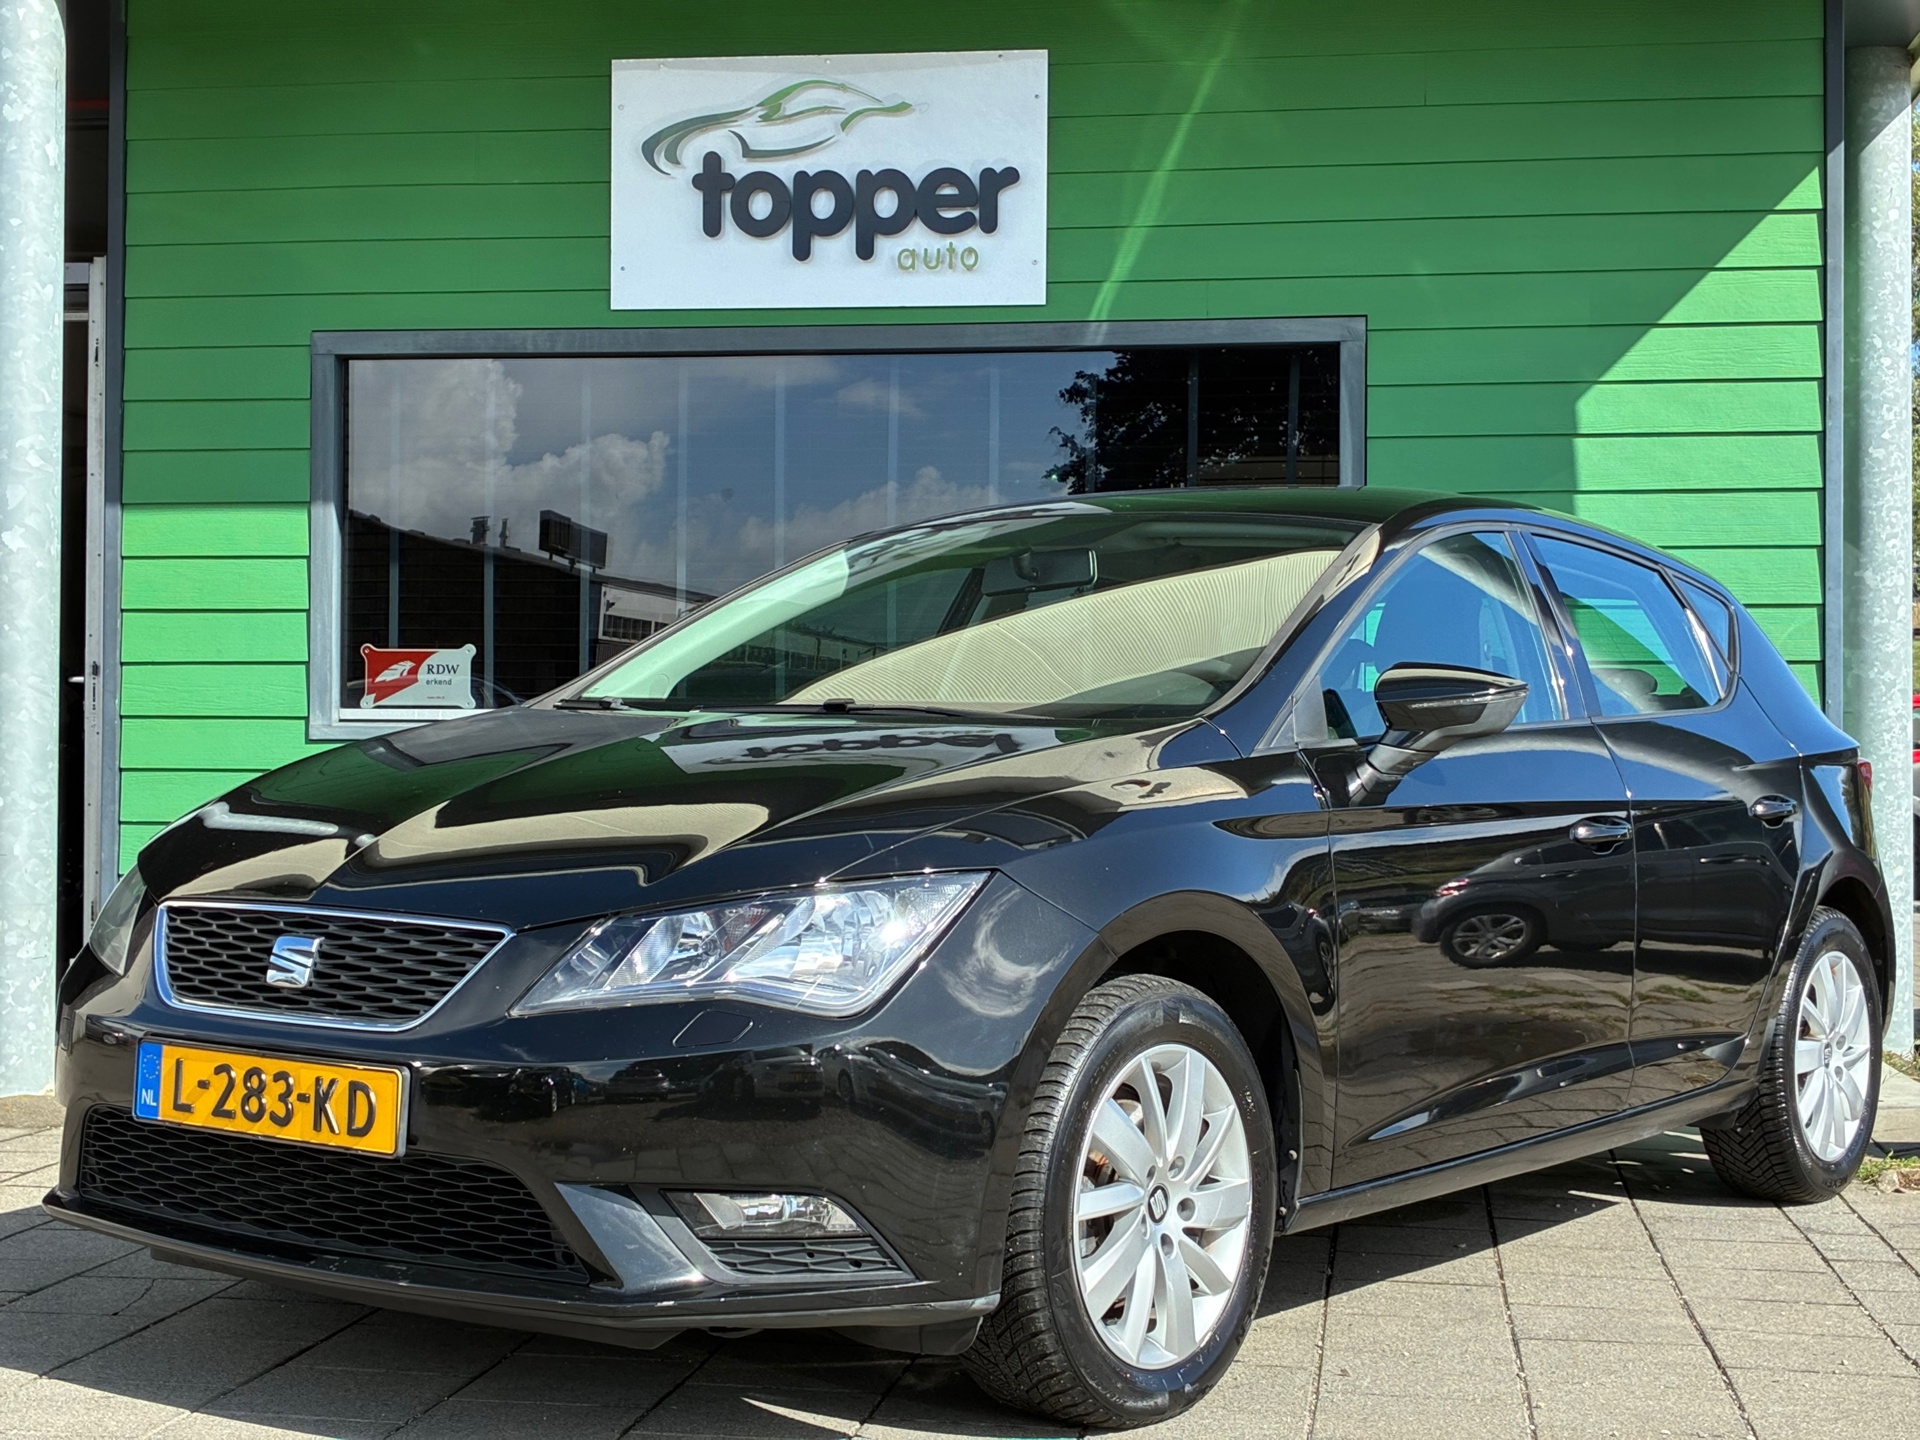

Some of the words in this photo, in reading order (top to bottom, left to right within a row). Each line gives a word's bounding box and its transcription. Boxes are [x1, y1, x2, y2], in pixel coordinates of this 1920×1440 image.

[692, 151, 1020, 261] topper
[898, 242, 979, 271] auto
[426, 664, 460, 674] RDW
[141, 1088, 157, 1107] NL
[172, 1057, 377, 1138] L-283-KD
